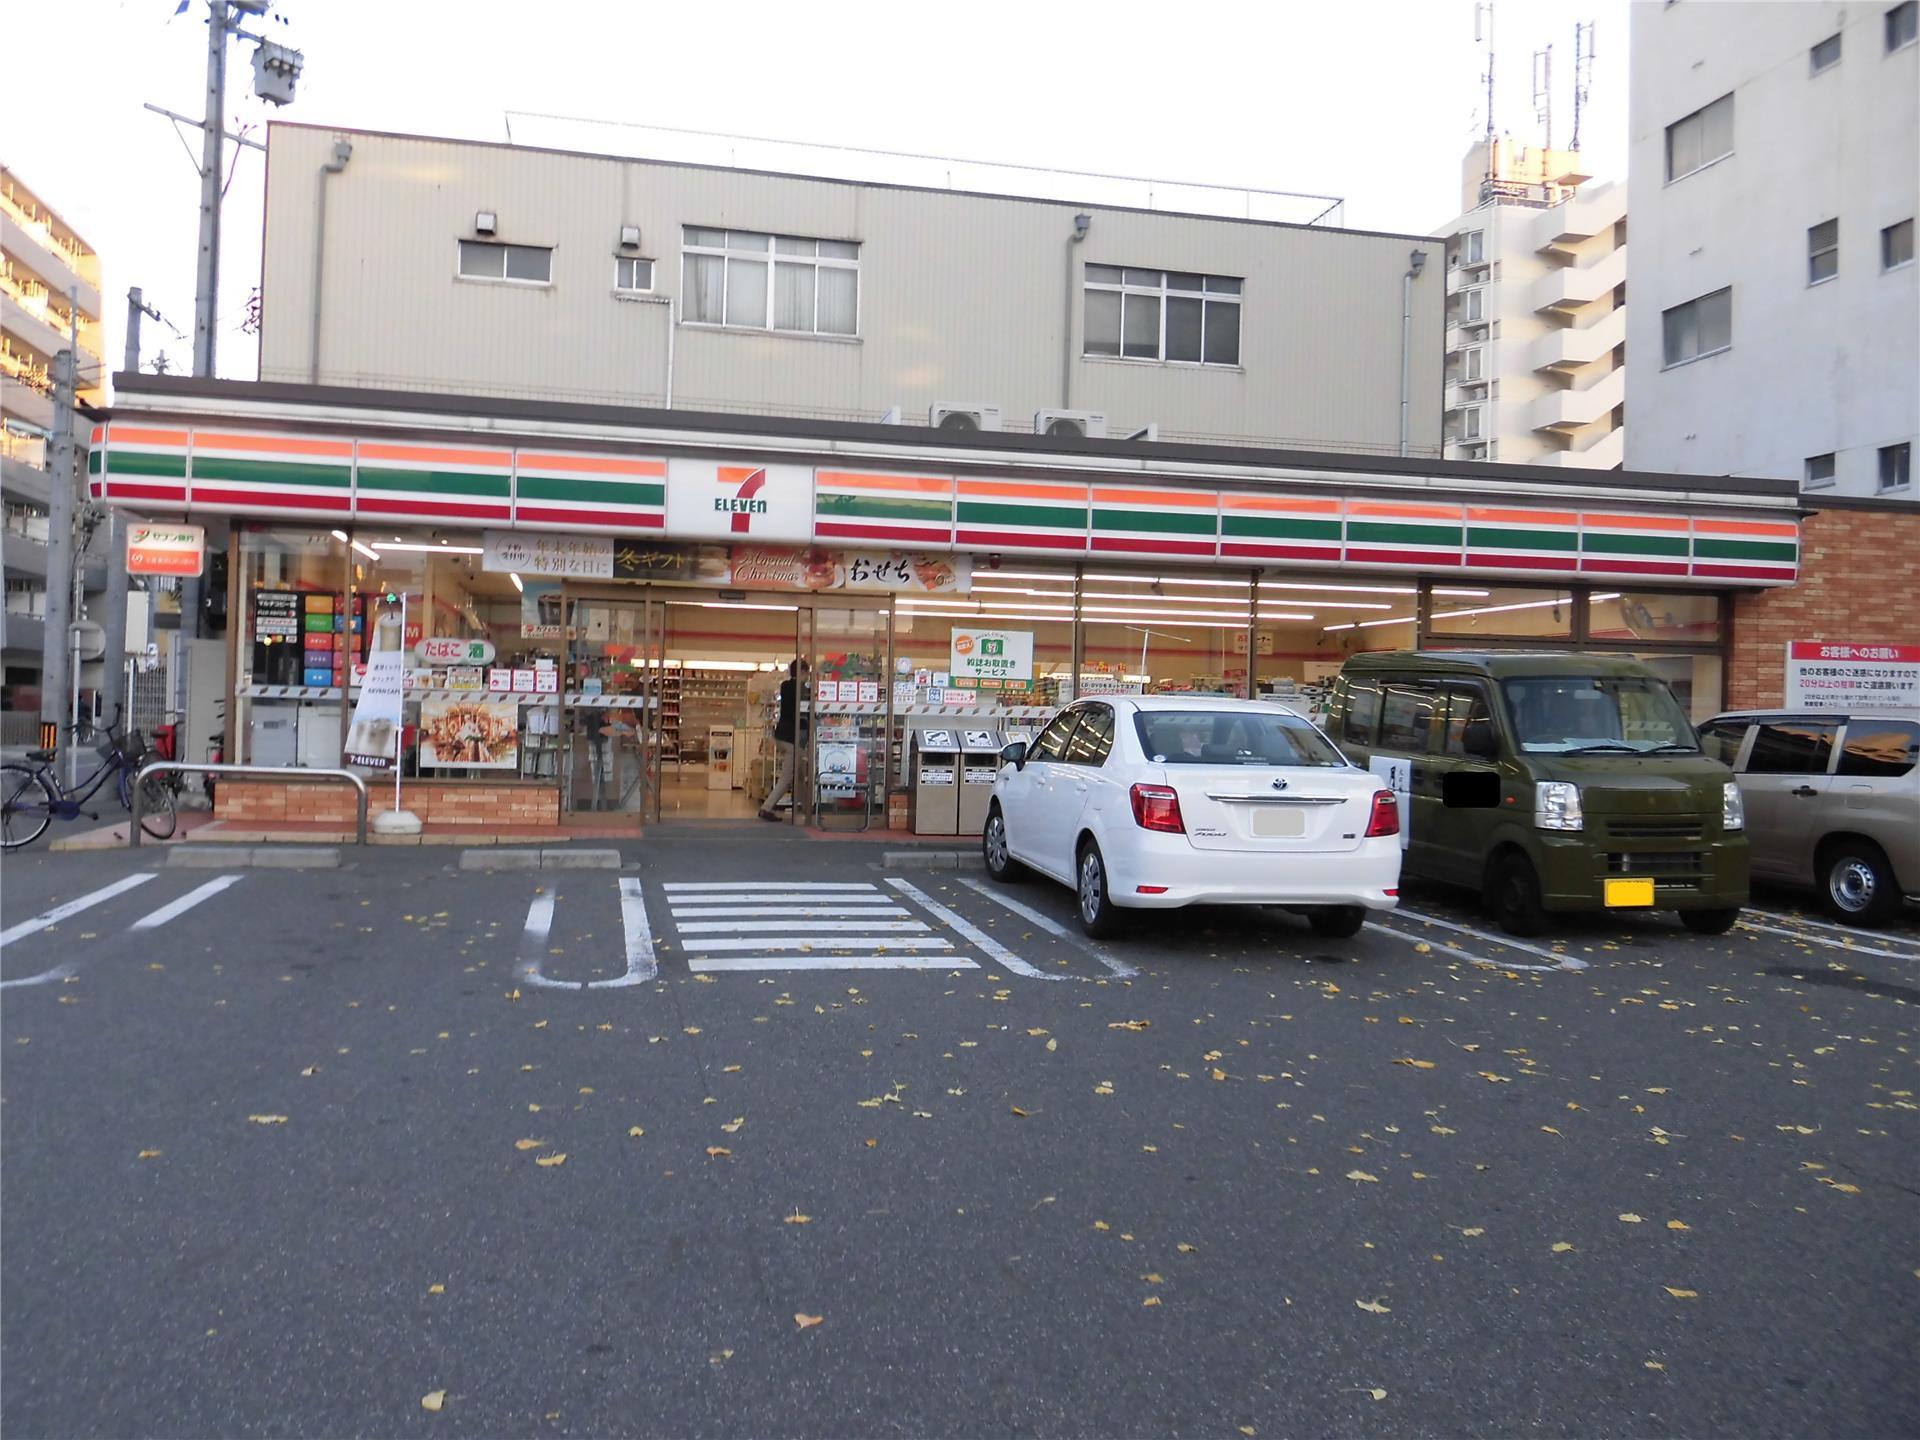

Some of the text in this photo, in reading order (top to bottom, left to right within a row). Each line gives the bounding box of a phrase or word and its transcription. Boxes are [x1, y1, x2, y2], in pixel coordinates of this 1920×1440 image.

[536, 539, 609, 556] 年末年始の
[534, 556, 609, 574] 特別な日に
[617, 547, 685, 571] 冬ギフト
[735, 565, 800, 583] Christmas
[851, 559, 911, 583] おせち
[425, 642, 484, 658] たばこ 酒
[1820, 646, 1899, 659] お客様へのお願い
[966, 658, 1016, 669] 雑誌お取置き
[975, 668, 1007, 676] サービス
